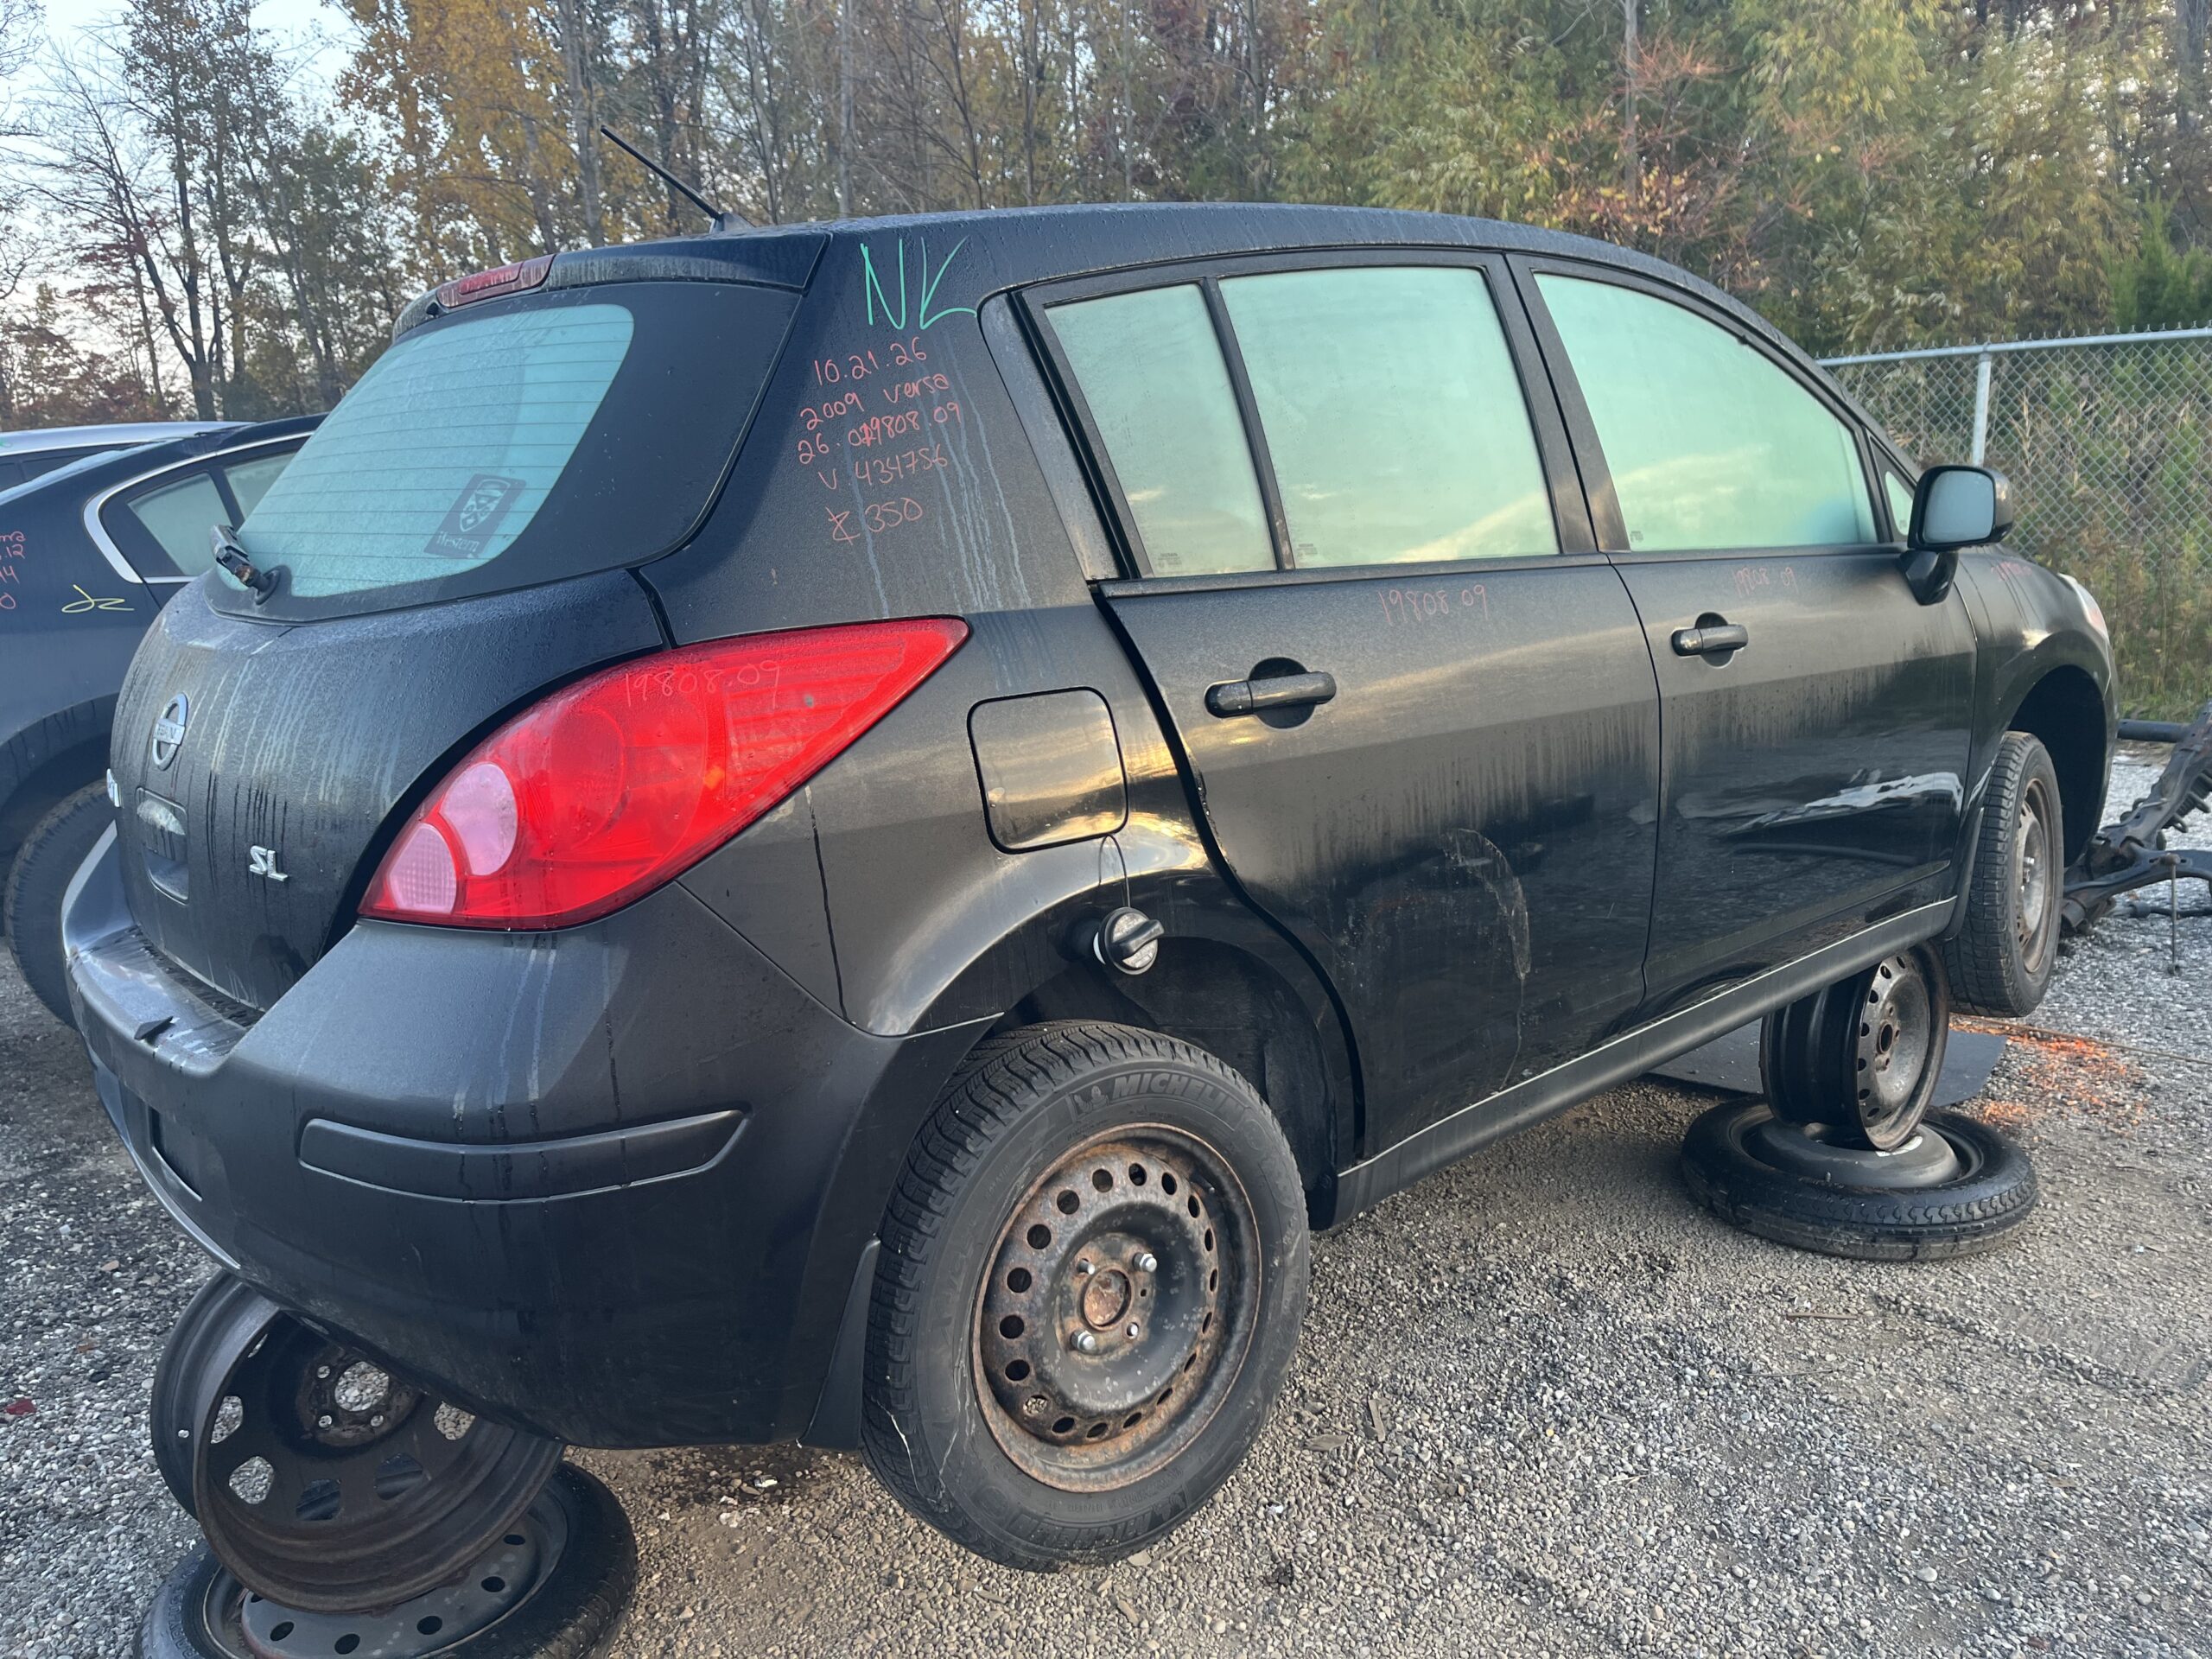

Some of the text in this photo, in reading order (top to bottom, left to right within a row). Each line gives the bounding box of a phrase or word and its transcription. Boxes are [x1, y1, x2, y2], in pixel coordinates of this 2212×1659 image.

[814, 337, 927, 386] 10.21.26
[800, 392, 865, 430] 2009
[855, 443, 948, 486] 434756
[865, 497, 923, 532] 350
[626, 659, 781, 709] 19808.09
[250, 845, 289, 882] SL
[1111, 1071, 1246, 1121] MICHELIN
